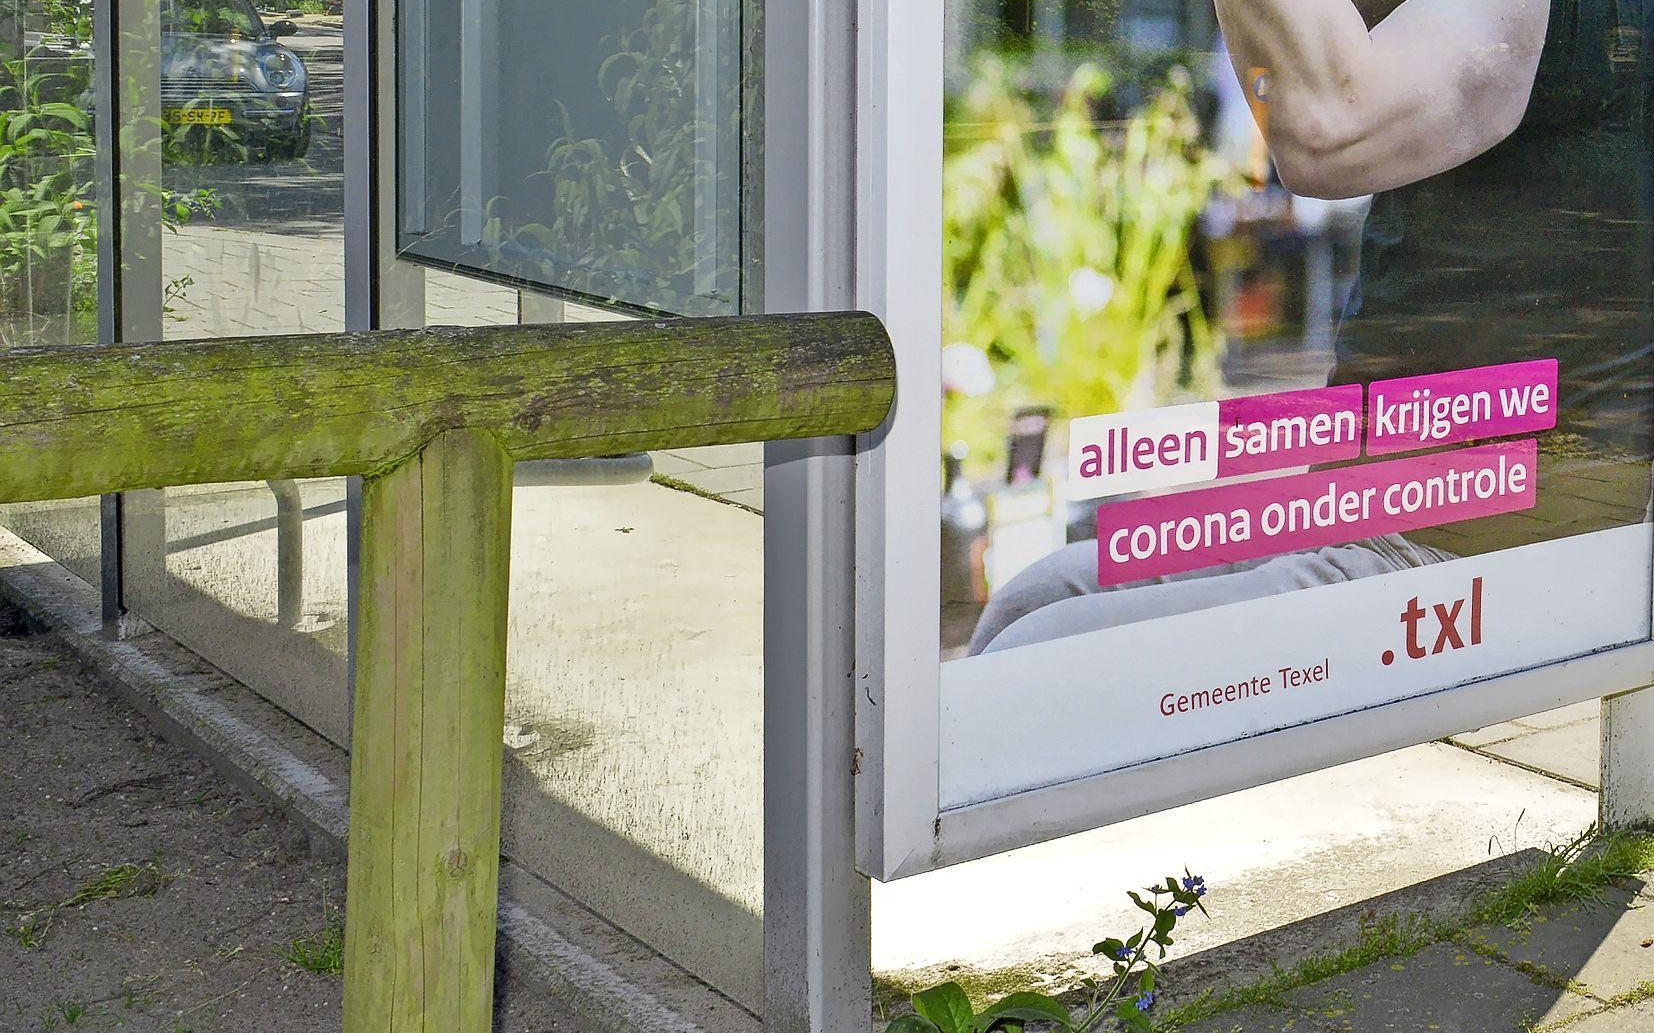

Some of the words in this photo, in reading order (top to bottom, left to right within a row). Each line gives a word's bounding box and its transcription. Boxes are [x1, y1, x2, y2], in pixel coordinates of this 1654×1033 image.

[1078, 427, 1208, 479] alleen
[1224, 409, 1357, 459] samen
[1374, 390, 1491, 442] krijgen
[1498, 382, 1550, 418] we
[1108, 507, 1252, 564] corona
[1260, 482, 1378, 537] onder
[1382, 454, 1528, 517] controle
[1381, 577, 1484, 666] .txl
[1158, 677, 1272, 717] Gemeente
[1279, 659, 1330, 688] Texel
